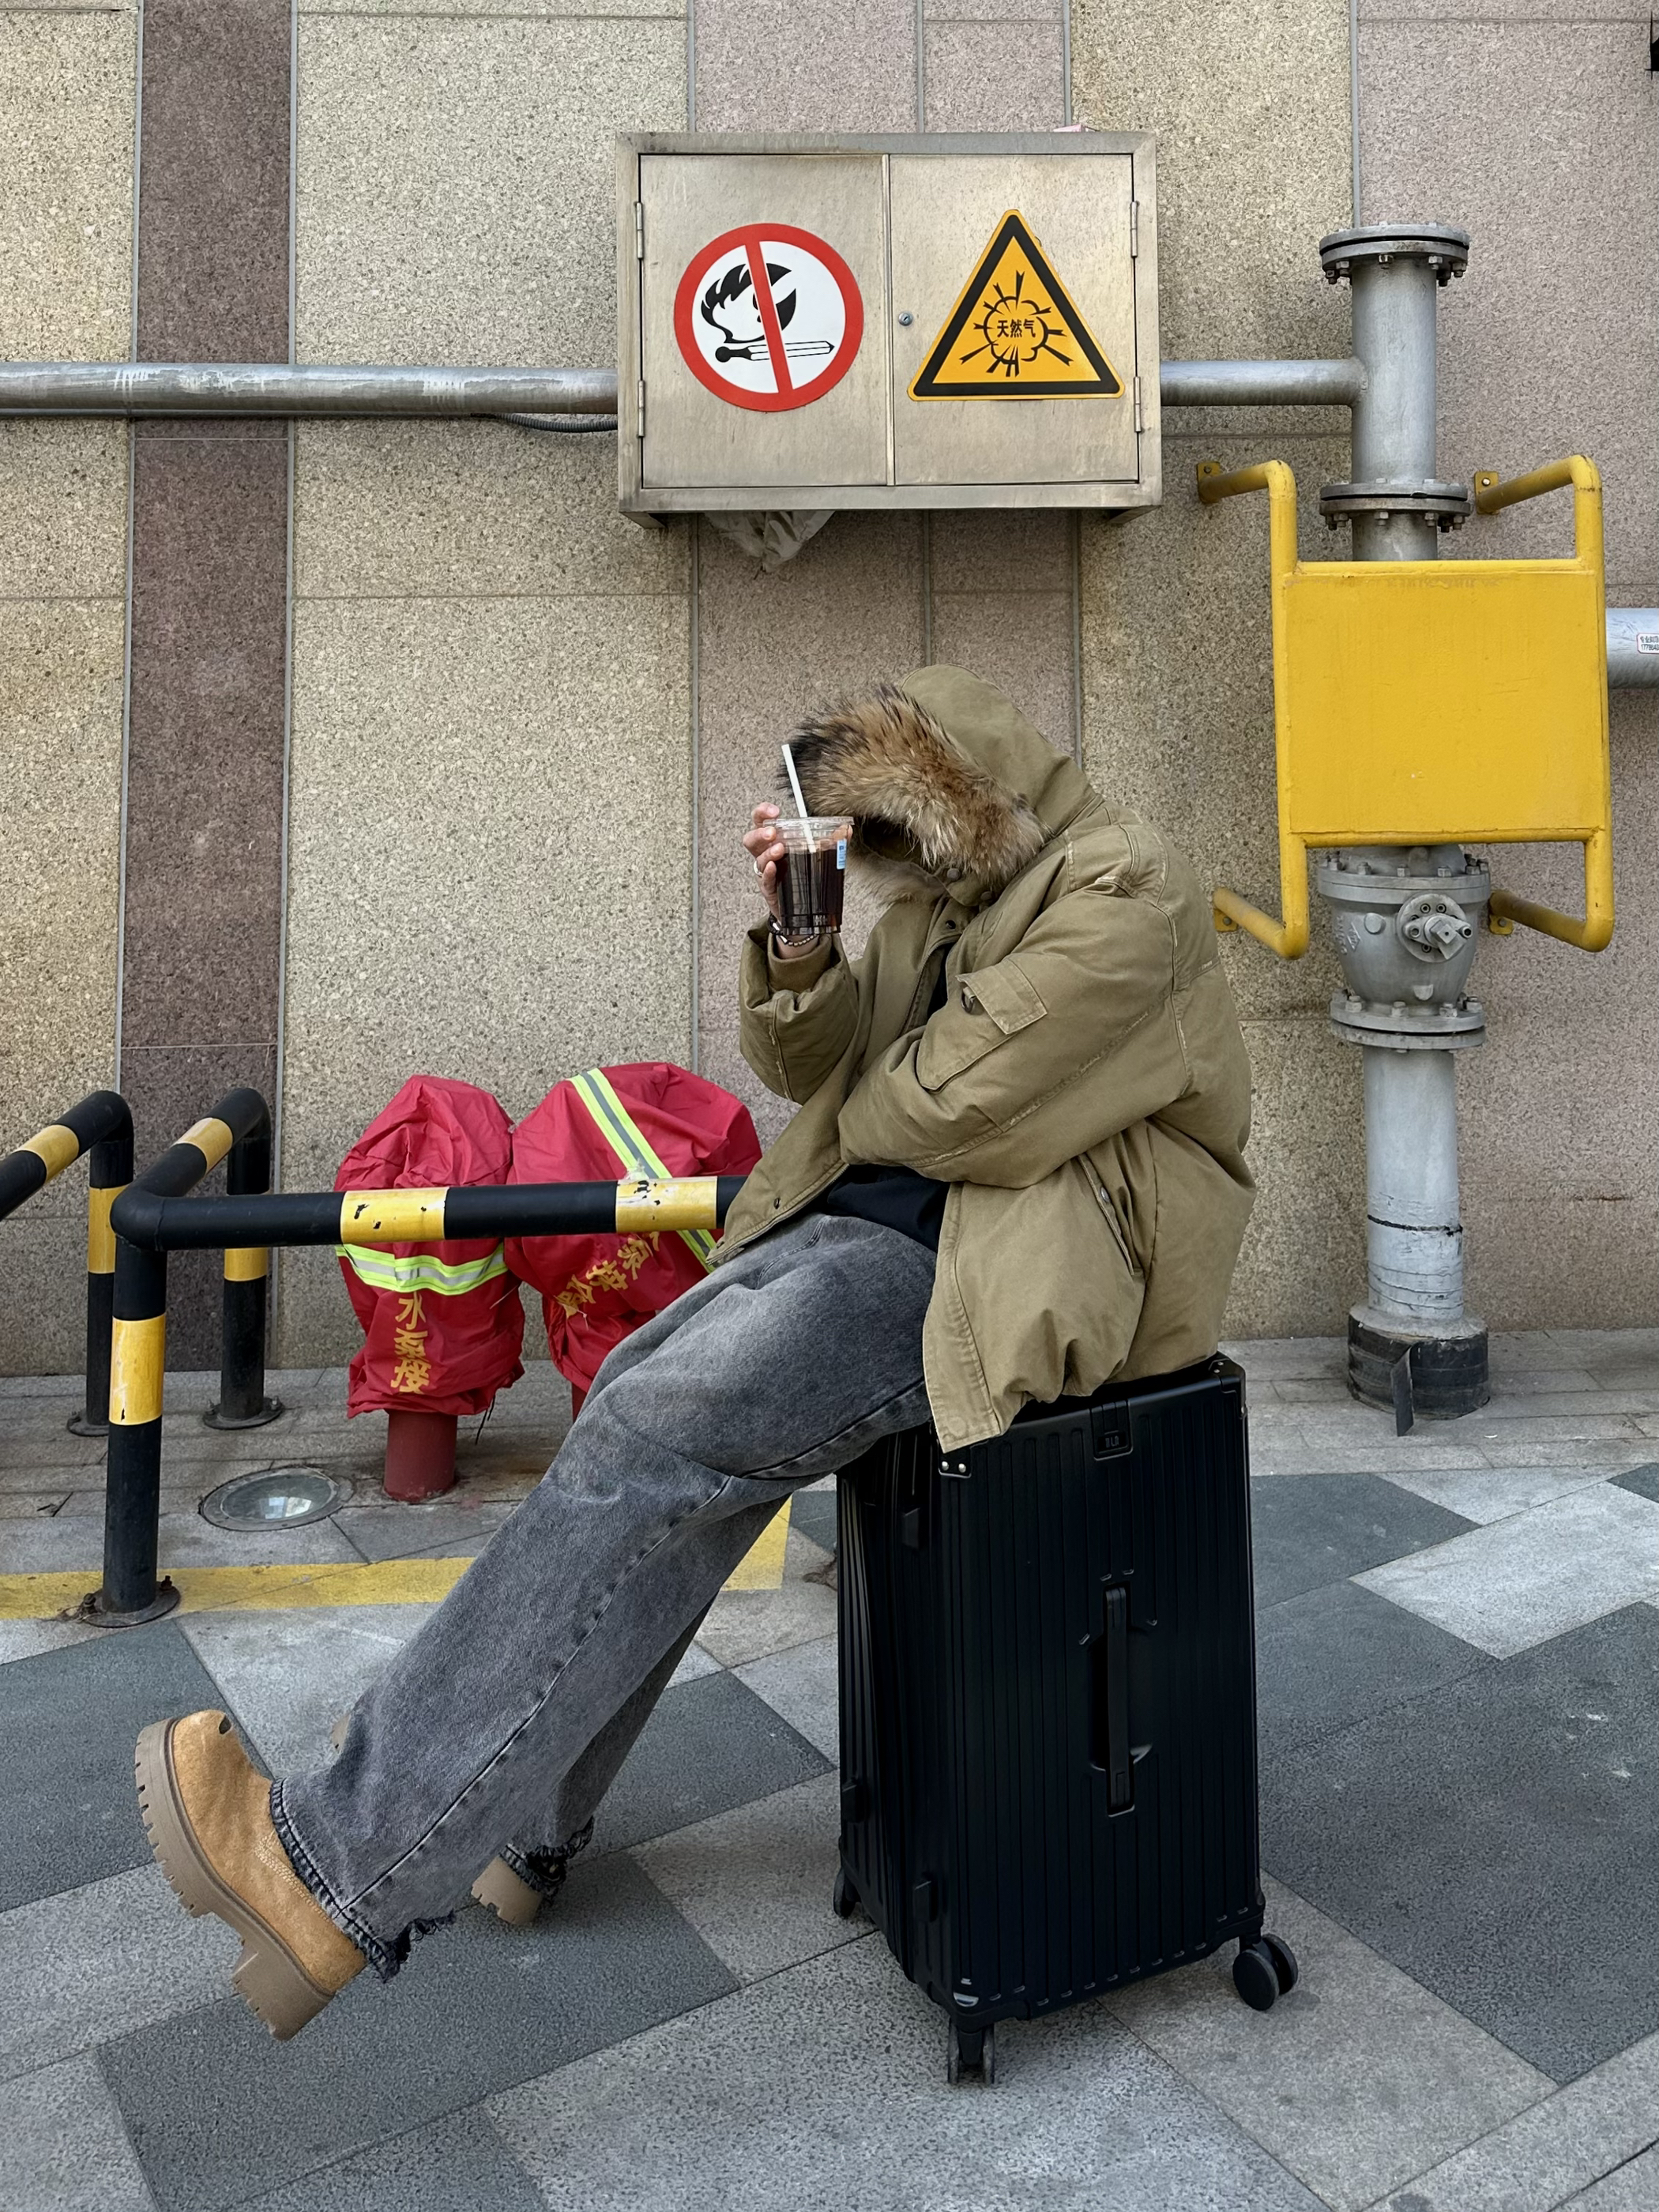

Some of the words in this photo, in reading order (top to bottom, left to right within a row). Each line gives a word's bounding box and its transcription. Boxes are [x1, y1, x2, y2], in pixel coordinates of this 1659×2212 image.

[996, 318, 1036, 338] 天然气
[390, 1291, 432, 1394] 水泵接
